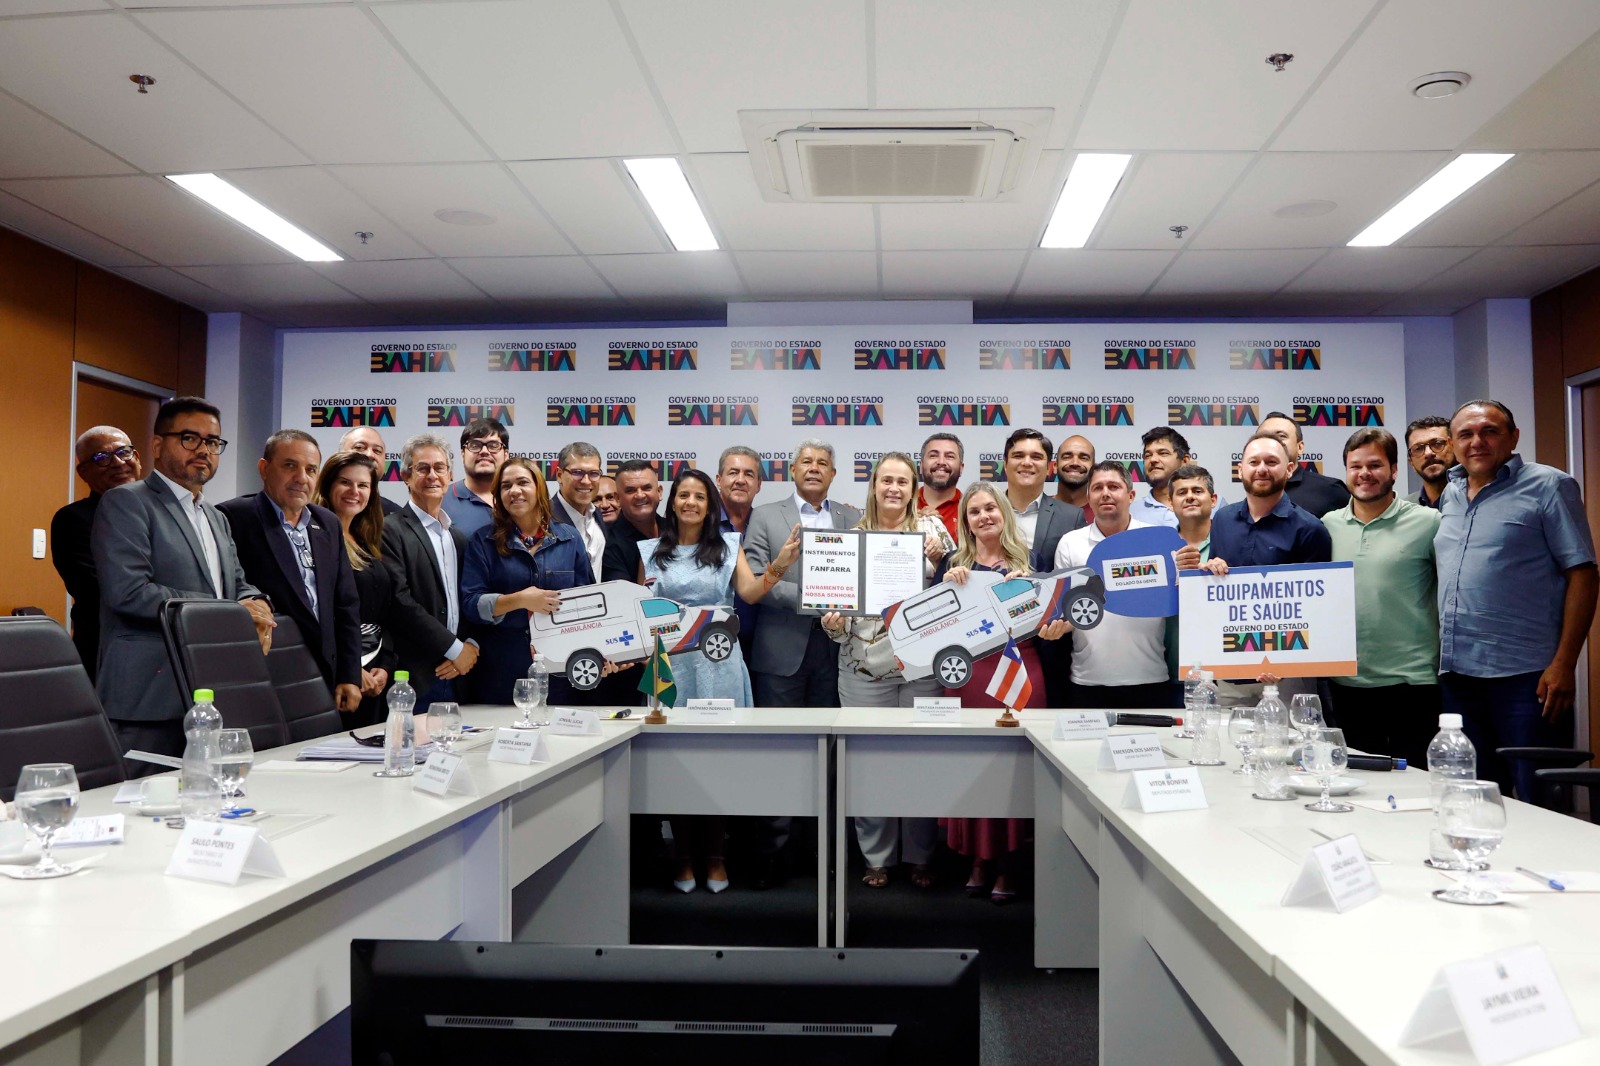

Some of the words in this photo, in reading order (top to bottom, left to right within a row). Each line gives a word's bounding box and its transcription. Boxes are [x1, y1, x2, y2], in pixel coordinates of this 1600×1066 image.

[371, 352, 456, 373] BAHIA
[489, 350, 576, 372] BAHIA
[609, 349, 698, 371] BAHIA
[731, 349, 821, 370] BAHIA
[855, 348, 946, 370] BAHIA
[979, 348, 1071, 370] BAHIA
[1104, 348, 1196, 370] BAHIA
[1230, 349, 1321, 370] BAHIA
[312, 406, 396, 427] BAHIA
[428, 406, 515, 426] BAHIA
[547, 405, 636, 426] BAHIA
[669, 404, 758, 426] BAHIA
[792, 404, 883, 426] BAHIA
[917, 404, 1008, 426] BAHIA
[1043, 404, 1134, 426] BAHIA
[1168, 404, 1260, 426] BAHIA
[1293, 405, 1384, 426] BAHIA
[1112, 564, 1158, 578] BAHIA
[1207, 580, 1325, 602] EQUIPAMENTOS
[1229, 605, 1248, 622] DE
[1253, 601, 1302, 621] SAÚDE
[966, 628, 979, 638] SUS
[1223, 624, 1262, 632] GOVERNO
[1223, 630, 1309, 652] BAHIA
[191, 837, 211, 846] SAULO
[211, 840, 235, 850] PONTES
